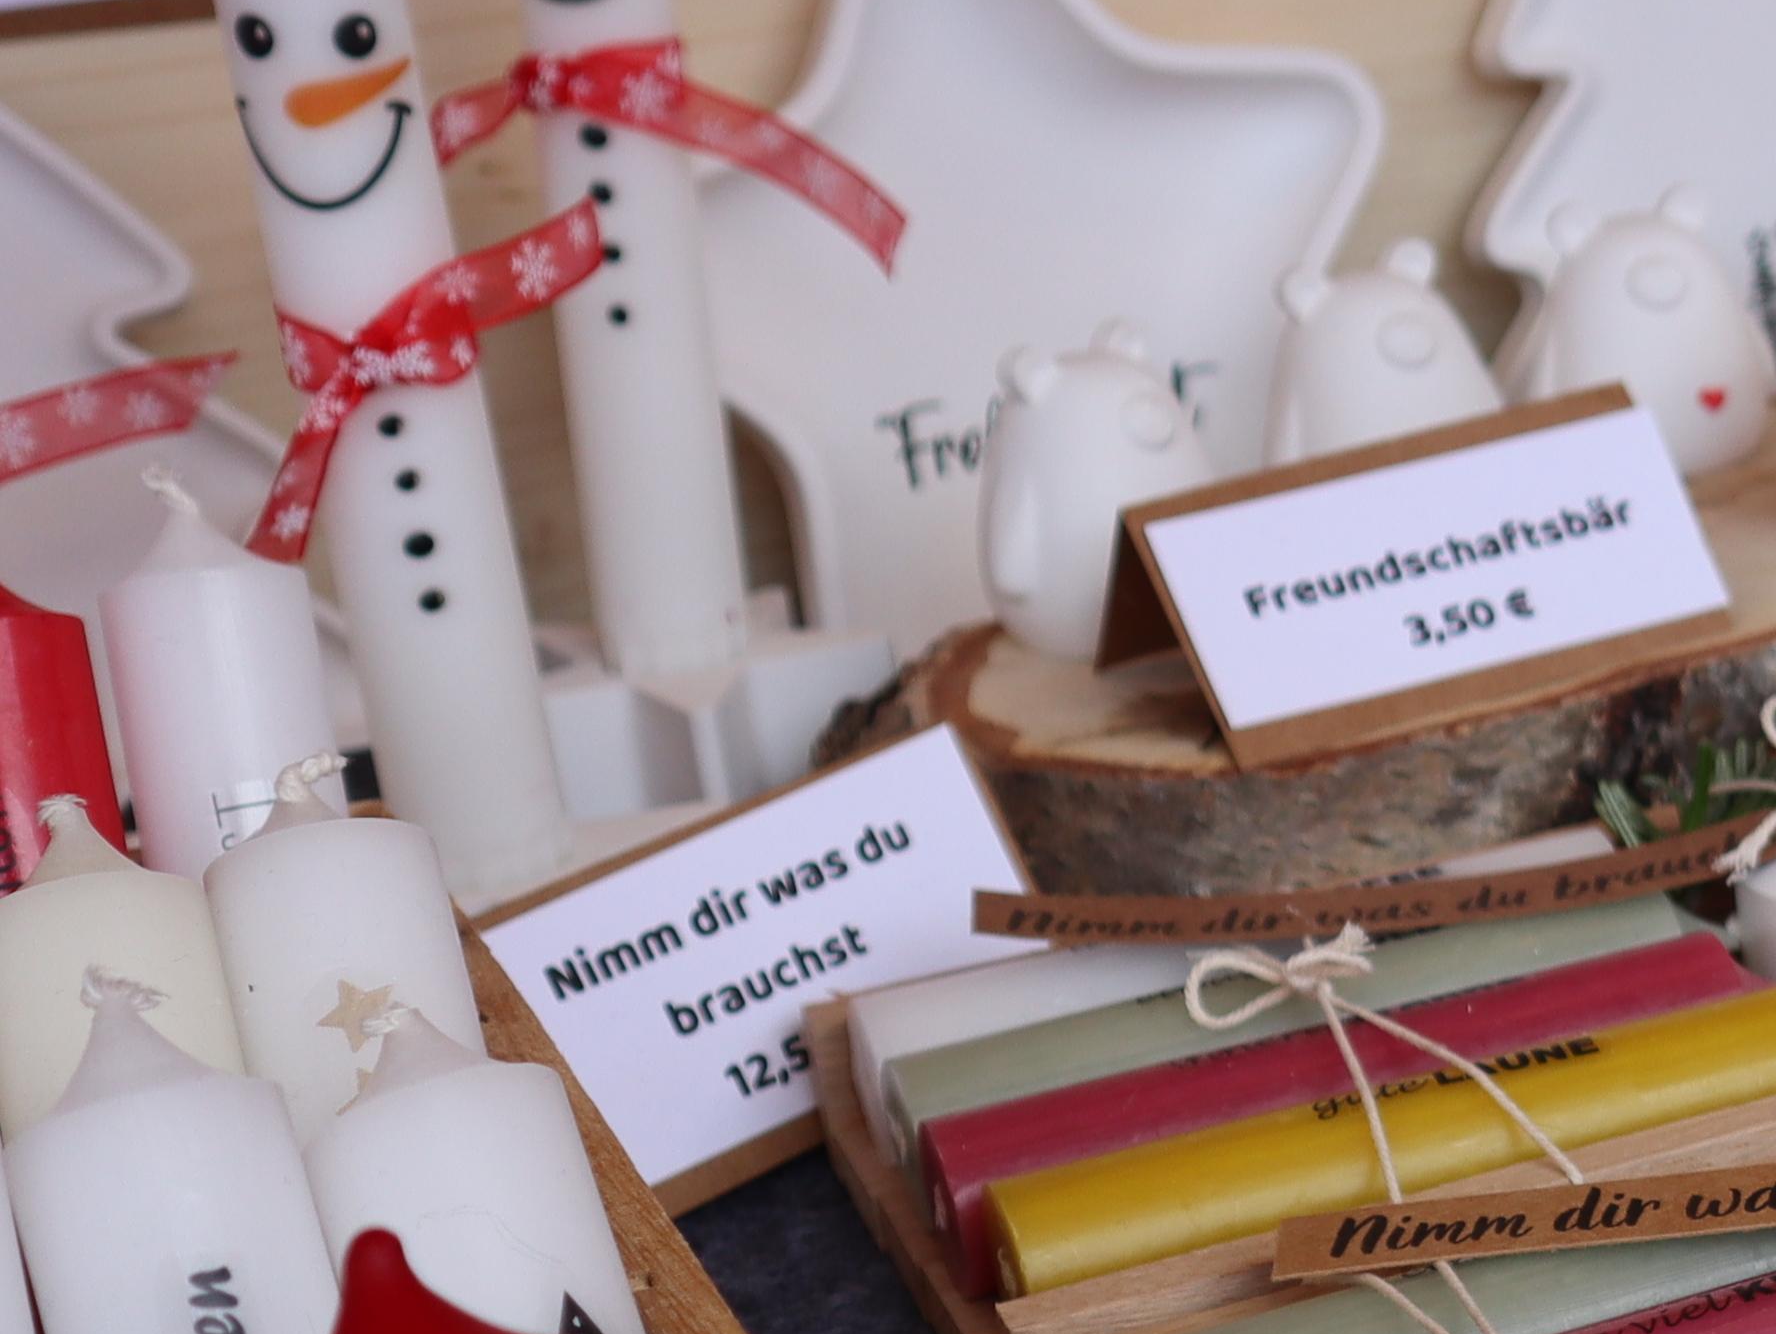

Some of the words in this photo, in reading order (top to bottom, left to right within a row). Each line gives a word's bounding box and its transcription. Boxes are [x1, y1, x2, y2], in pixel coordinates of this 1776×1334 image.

[1244, 495, 1634, 619] Freundschaftsbär
[1403, 597, 1495, 649] 3,50
[1504, 587, 1537, 620] €
[542, 921, 683, 1001] Nimm
[689, 886, 750, 939] dir
[756, 850, 850, 909] was
[857, 820, 912, 867] du
[665, 924, 869, 1037] brauchst
[724, 1032, 810, 1098] 12,5
[1330, 1213, 1533, 1259] Nimm
[1553, 1186, 1661, 1233] dir
